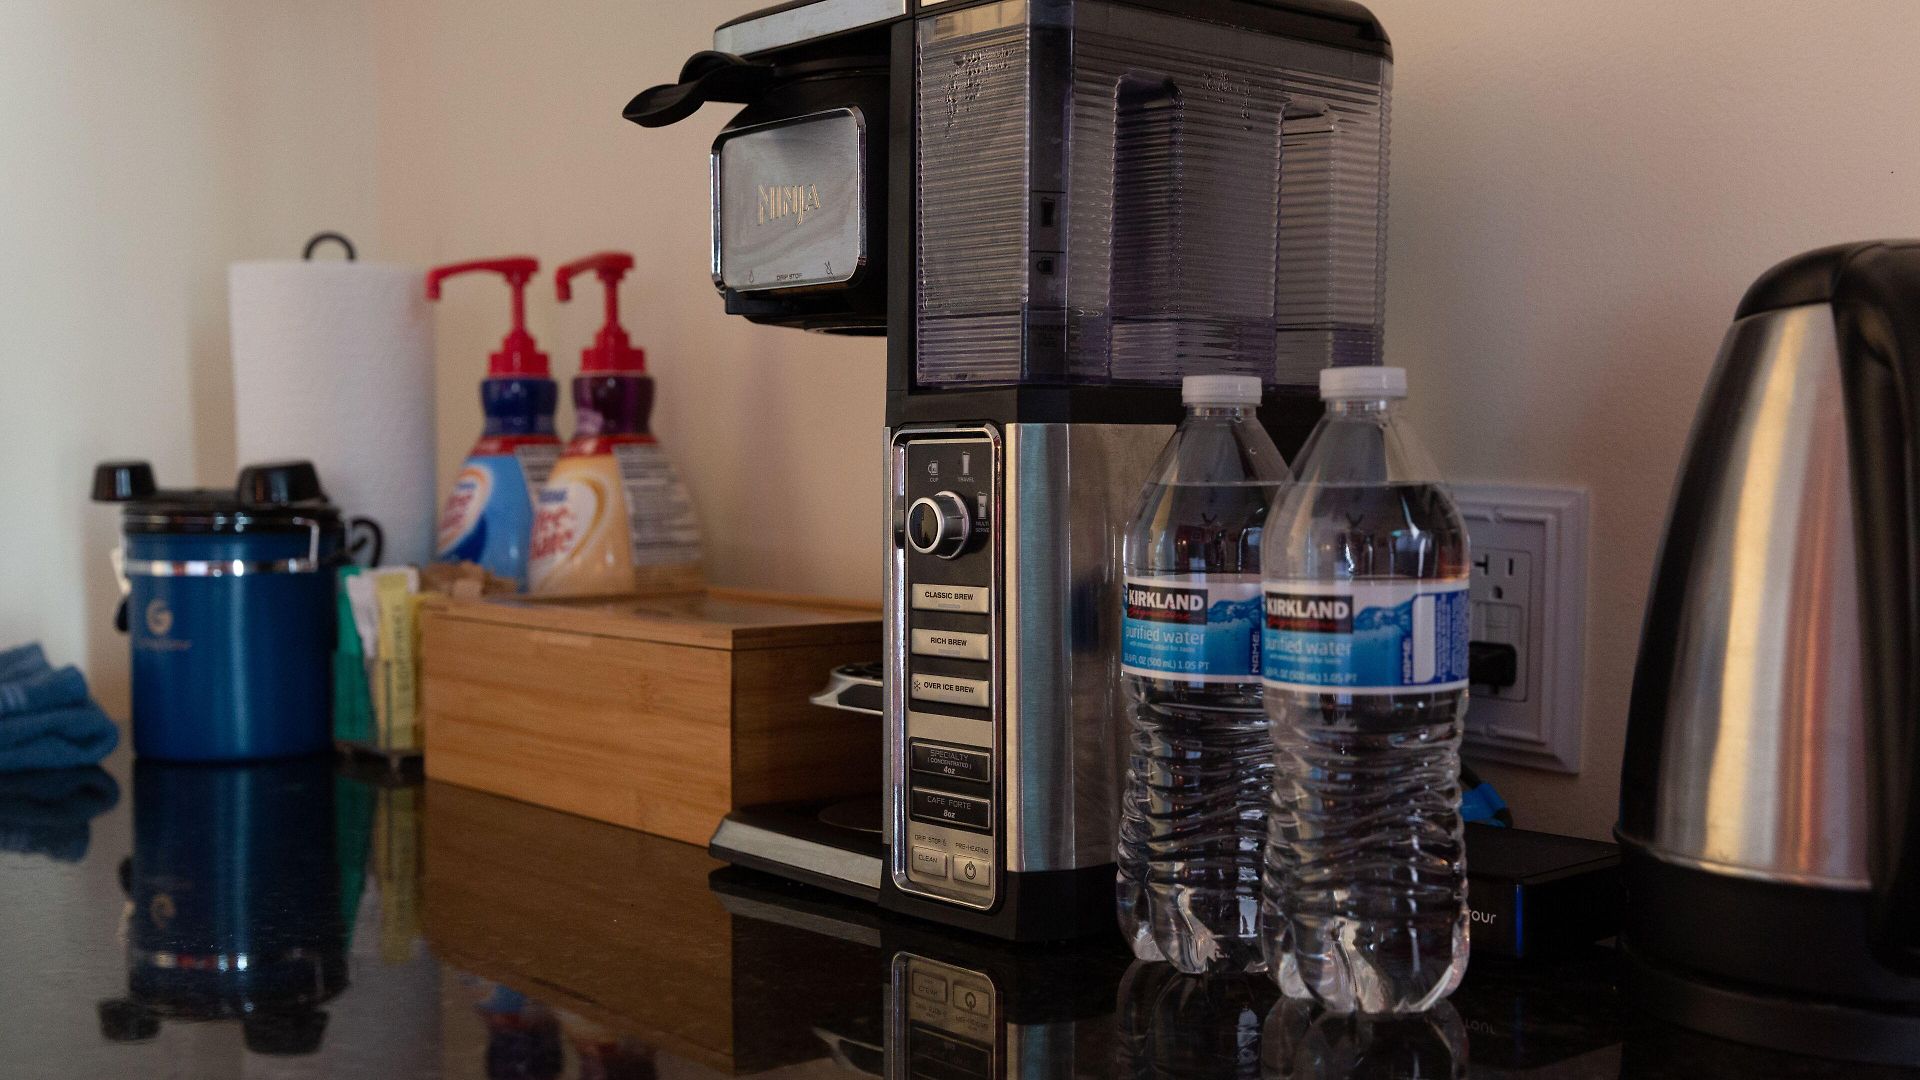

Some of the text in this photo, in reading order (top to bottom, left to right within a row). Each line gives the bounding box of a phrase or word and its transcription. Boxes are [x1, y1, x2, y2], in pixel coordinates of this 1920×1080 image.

[757, 183, 820, 227] NINJA
[924, 591, 974, 601] CLASSIC BREW
[1128, 589, 1204, 611] KIRKLAND
[1266, 598, 1350, 620] KIRKLAND
[930, 637, 968, 647] RICH BREW
[1163, 631, 1204, 645] water
[924, 681, 975, 694] OVER ICE BREW
